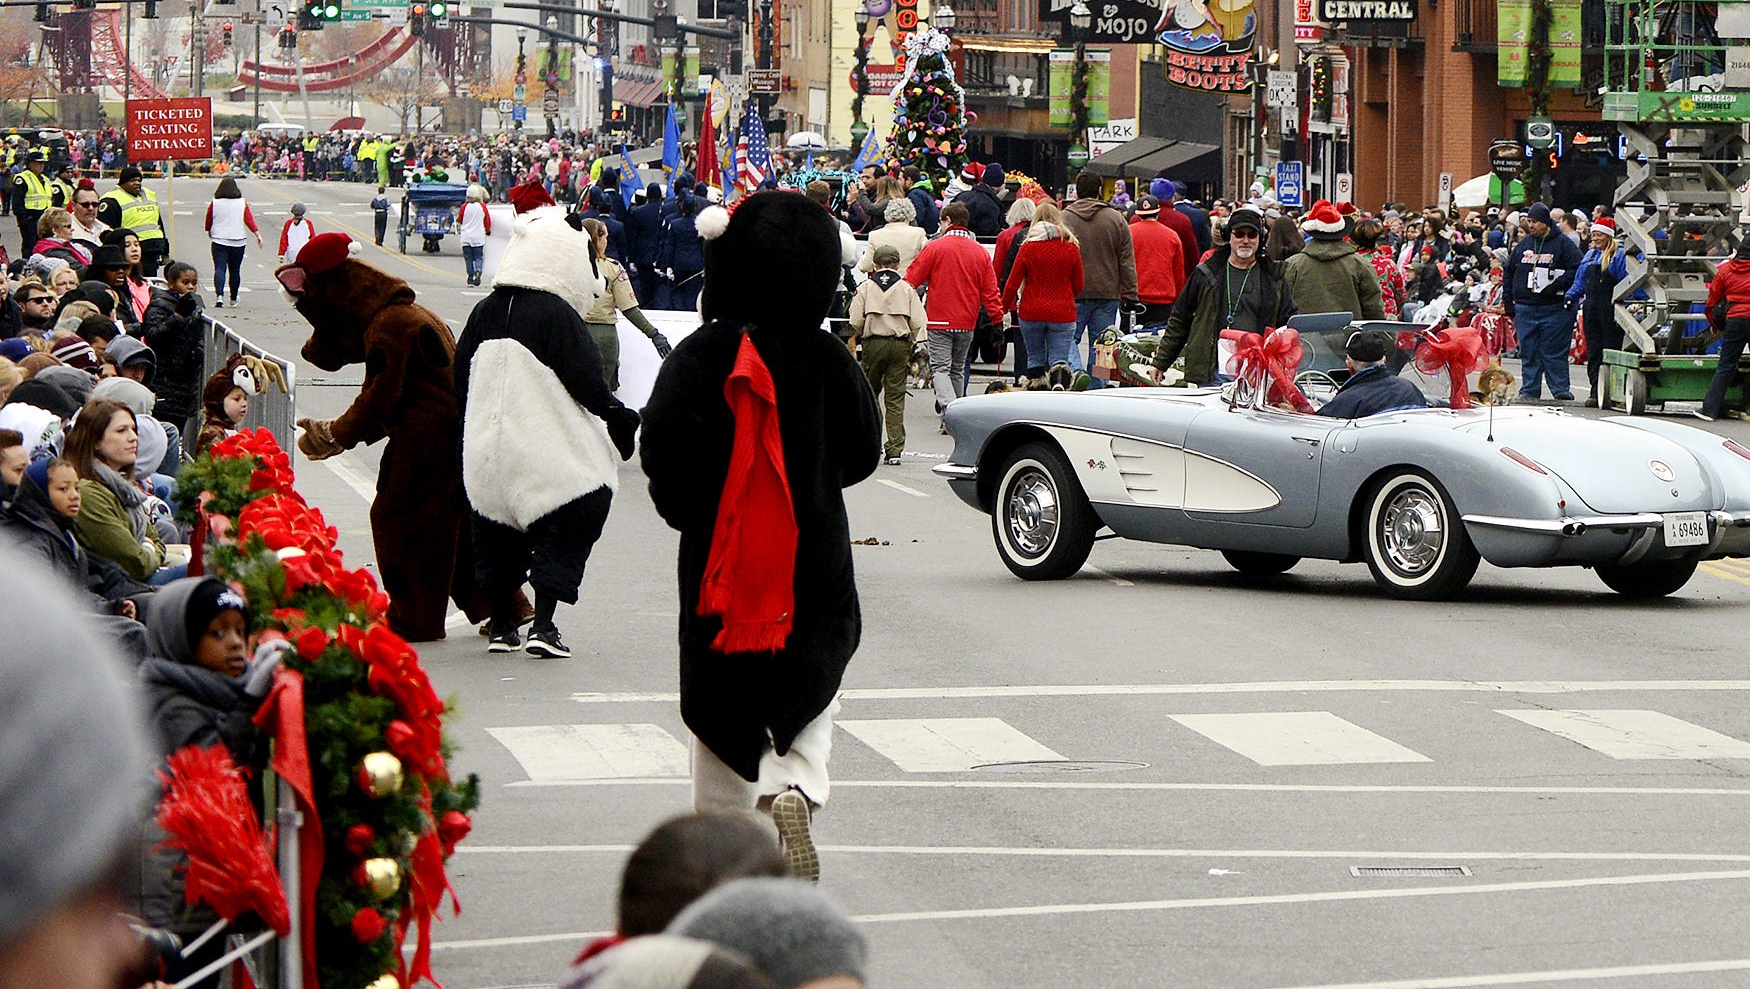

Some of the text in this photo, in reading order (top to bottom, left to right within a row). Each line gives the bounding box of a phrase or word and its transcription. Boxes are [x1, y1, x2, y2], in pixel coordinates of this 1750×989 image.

[1103, 4, 1118, 18] &
[1324, 0, 1413, 19] CENTRAL
[1096, 18, 1147, 41] MOJO
[1294, 27, 1314, 38] ITY
[1167, 50, 1251, 72] BETTY
[1168, 66, 1248, 91] BOOTS
[1269, 89, 1281, 101] OK
[135, 108, 203, 121] TICKETED
[141, 123, 198, 135] SEATING
[1093, 125, 1133, 138] PARK
[134, 138, 206, 150] ENTRANCE
[1282, 164, 1297, 172] TAXI
[1278, 172, 1300, 182] STAND
[1679, 522, 1703, 537] 69486
